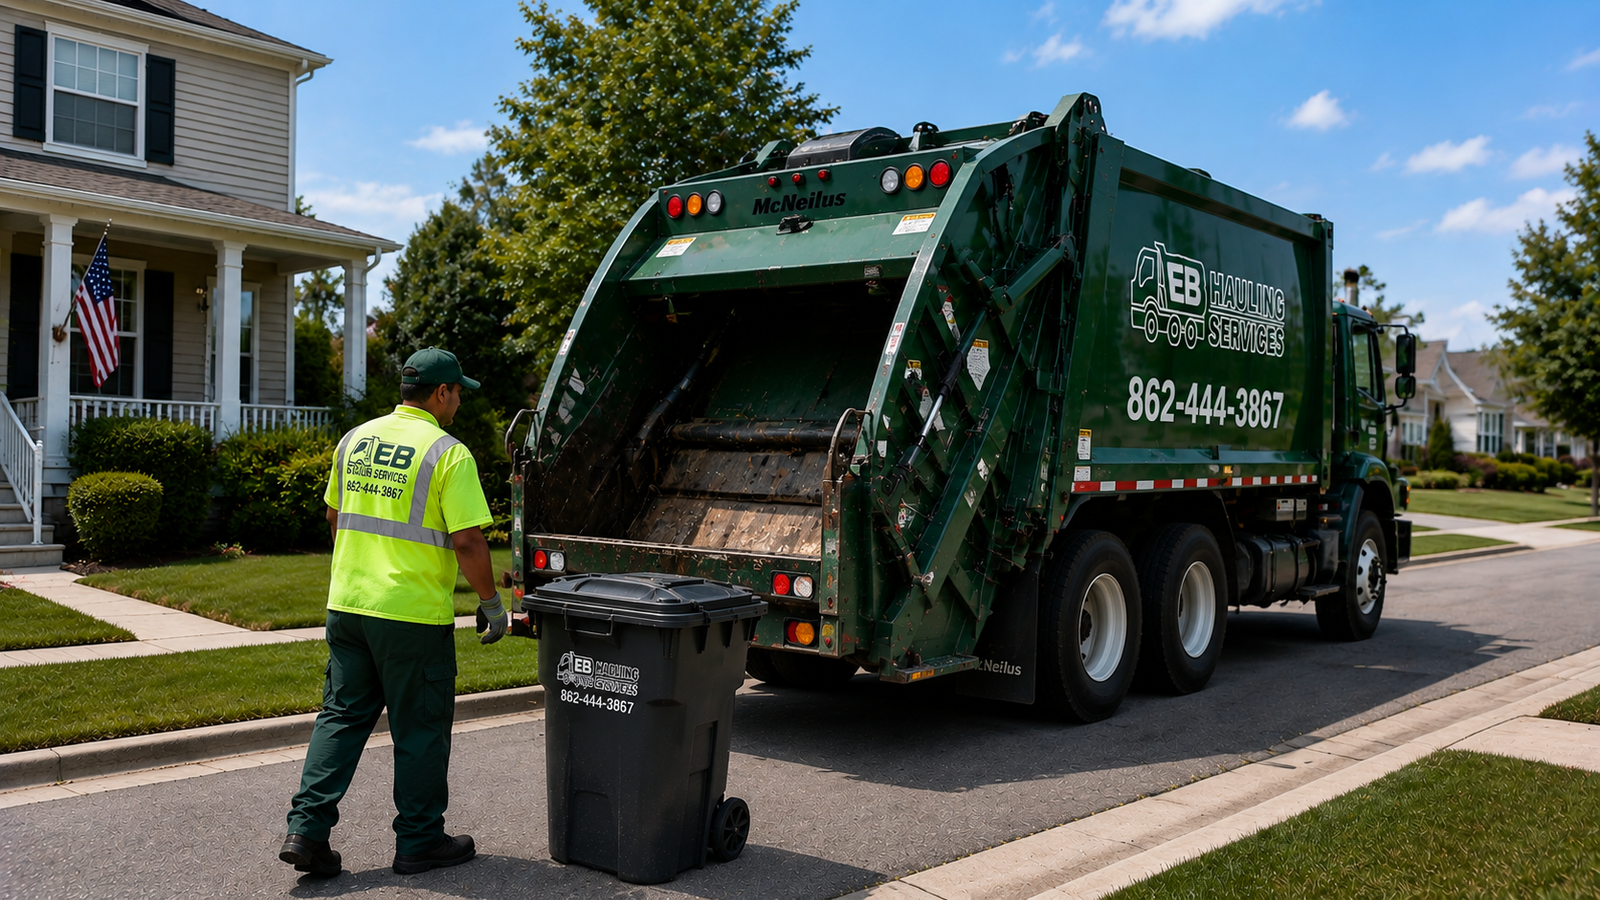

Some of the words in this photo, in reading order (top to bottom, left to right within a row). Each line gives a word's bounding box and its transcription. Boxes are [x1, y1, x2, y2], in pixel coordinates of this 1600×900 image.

[752, 190, 846, 215] McNeilus
[1166, 261, 1201, 307] EB
[1209, 270, 1286, 321] HAULING
[1208, 314, 1285, 358] SERVICES
[1126, 375, 1285, 429] 862-444-3867
[373, 443, 416, 470] EB
[373, 468, 408, 484] SERVICES
[575, 658, 592, 674] EB
[975, 659, 1022, 676] cNeilus
[560, 689, 634, 714] 862-444-3867
